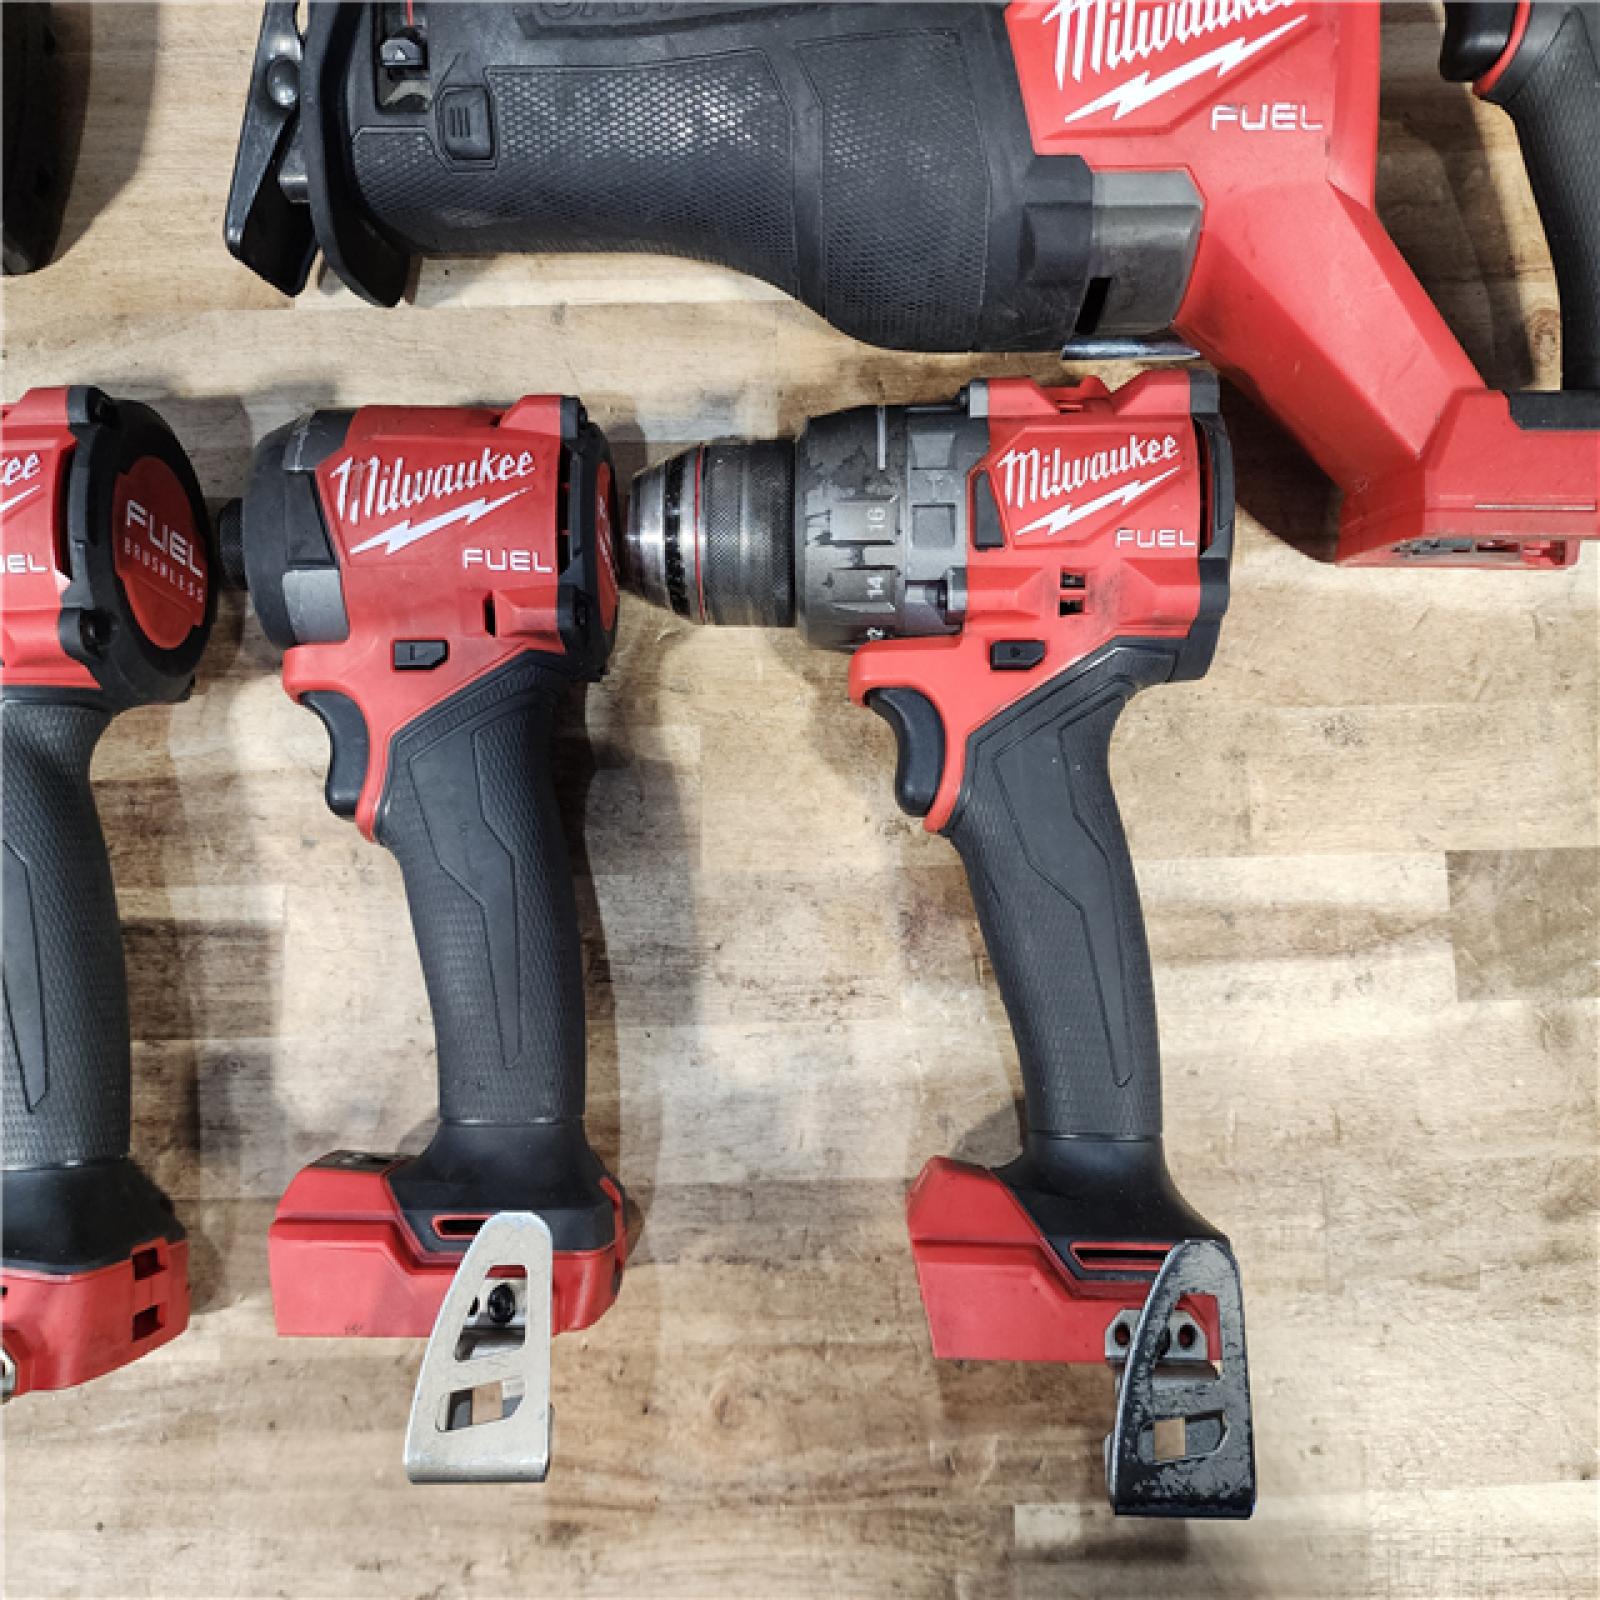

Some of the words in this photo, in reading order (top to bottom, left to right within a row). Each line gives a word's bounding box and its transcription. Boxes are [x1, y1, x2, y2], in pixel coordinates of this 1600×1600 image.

[1211, 103, 1323, 131] FUEL
[996, 434, 1180, 509] Milwaukee
[329, 447, 536, 525] Milwaukee
[125, 499, 204, 579] FUEL
[1114, 528, 1196, 549] FUEL
[0, 553, 48, 574] EL
[461, 547, 554, 574] FUEL
